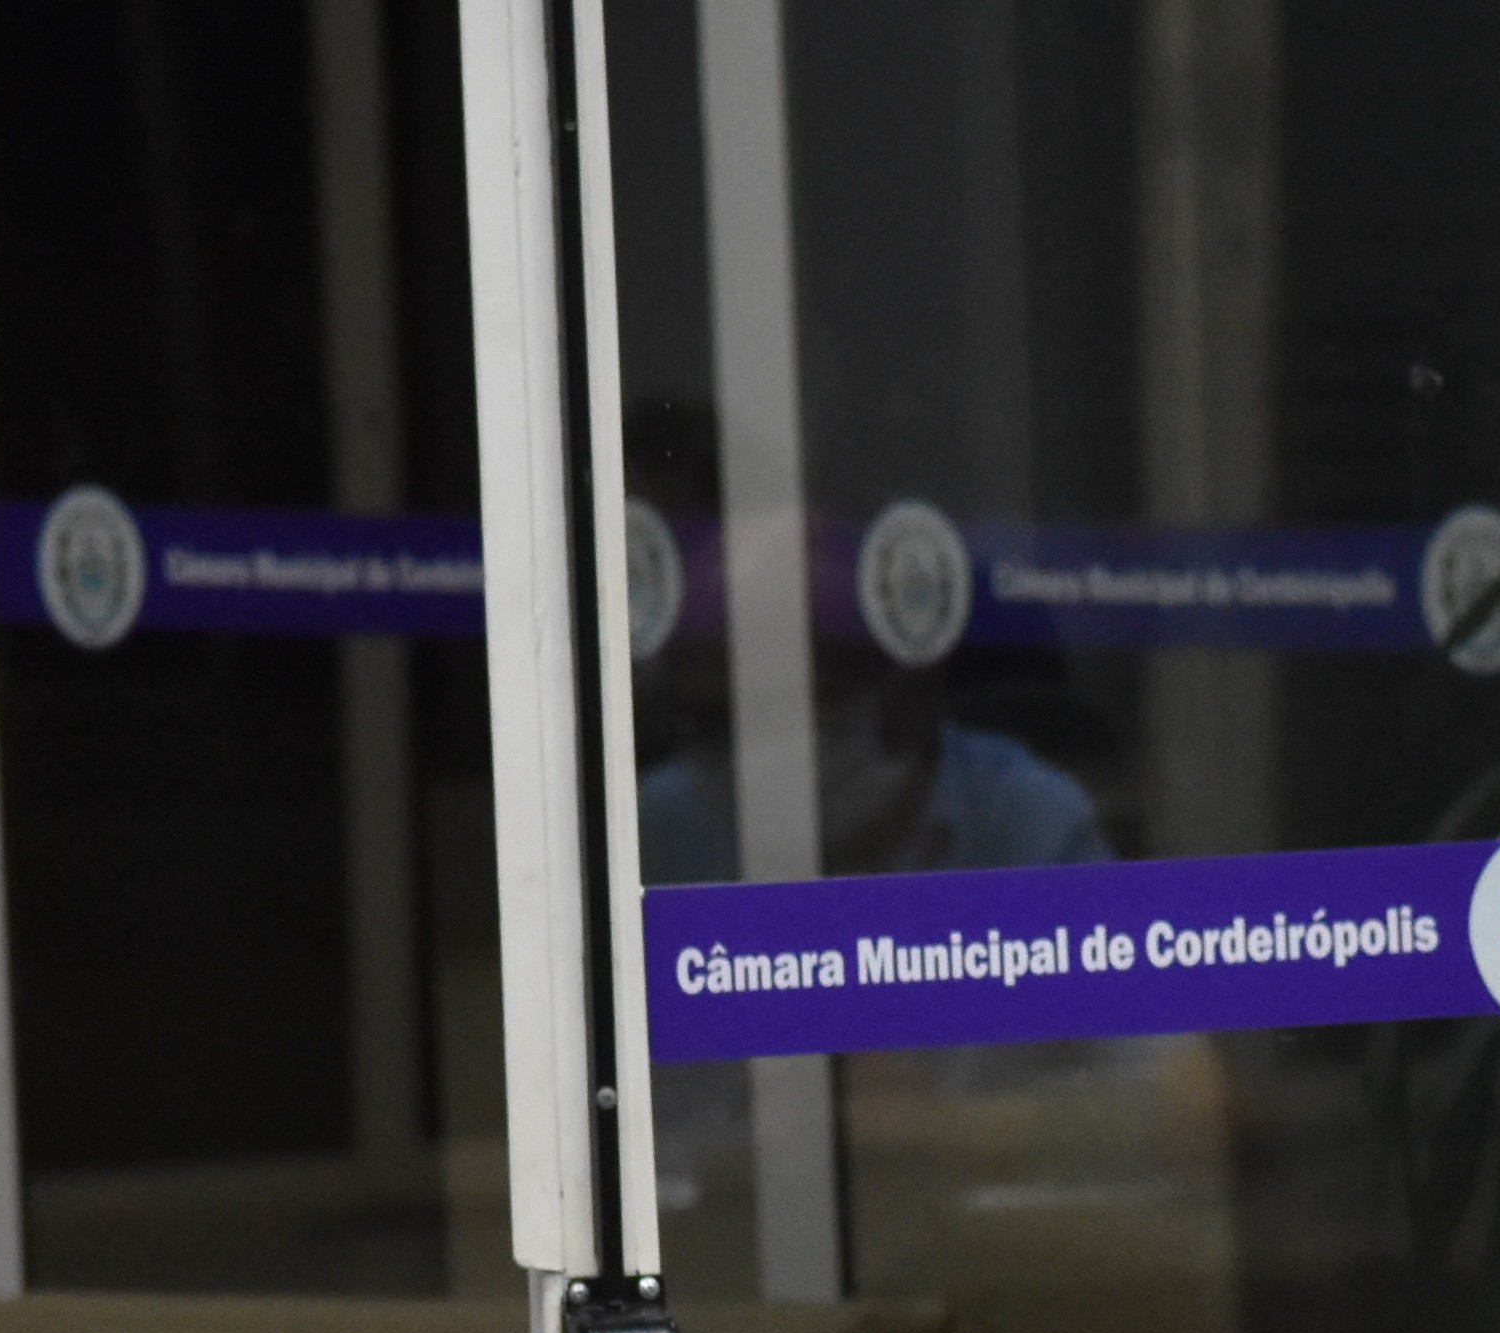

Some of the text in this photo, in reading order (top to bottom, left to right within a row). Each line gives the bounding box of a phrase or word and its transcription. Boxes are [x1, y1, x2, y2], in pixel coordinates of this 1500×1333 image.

[675, 904, 1441, 998] Câmara Municipal de Cordeirópolis
